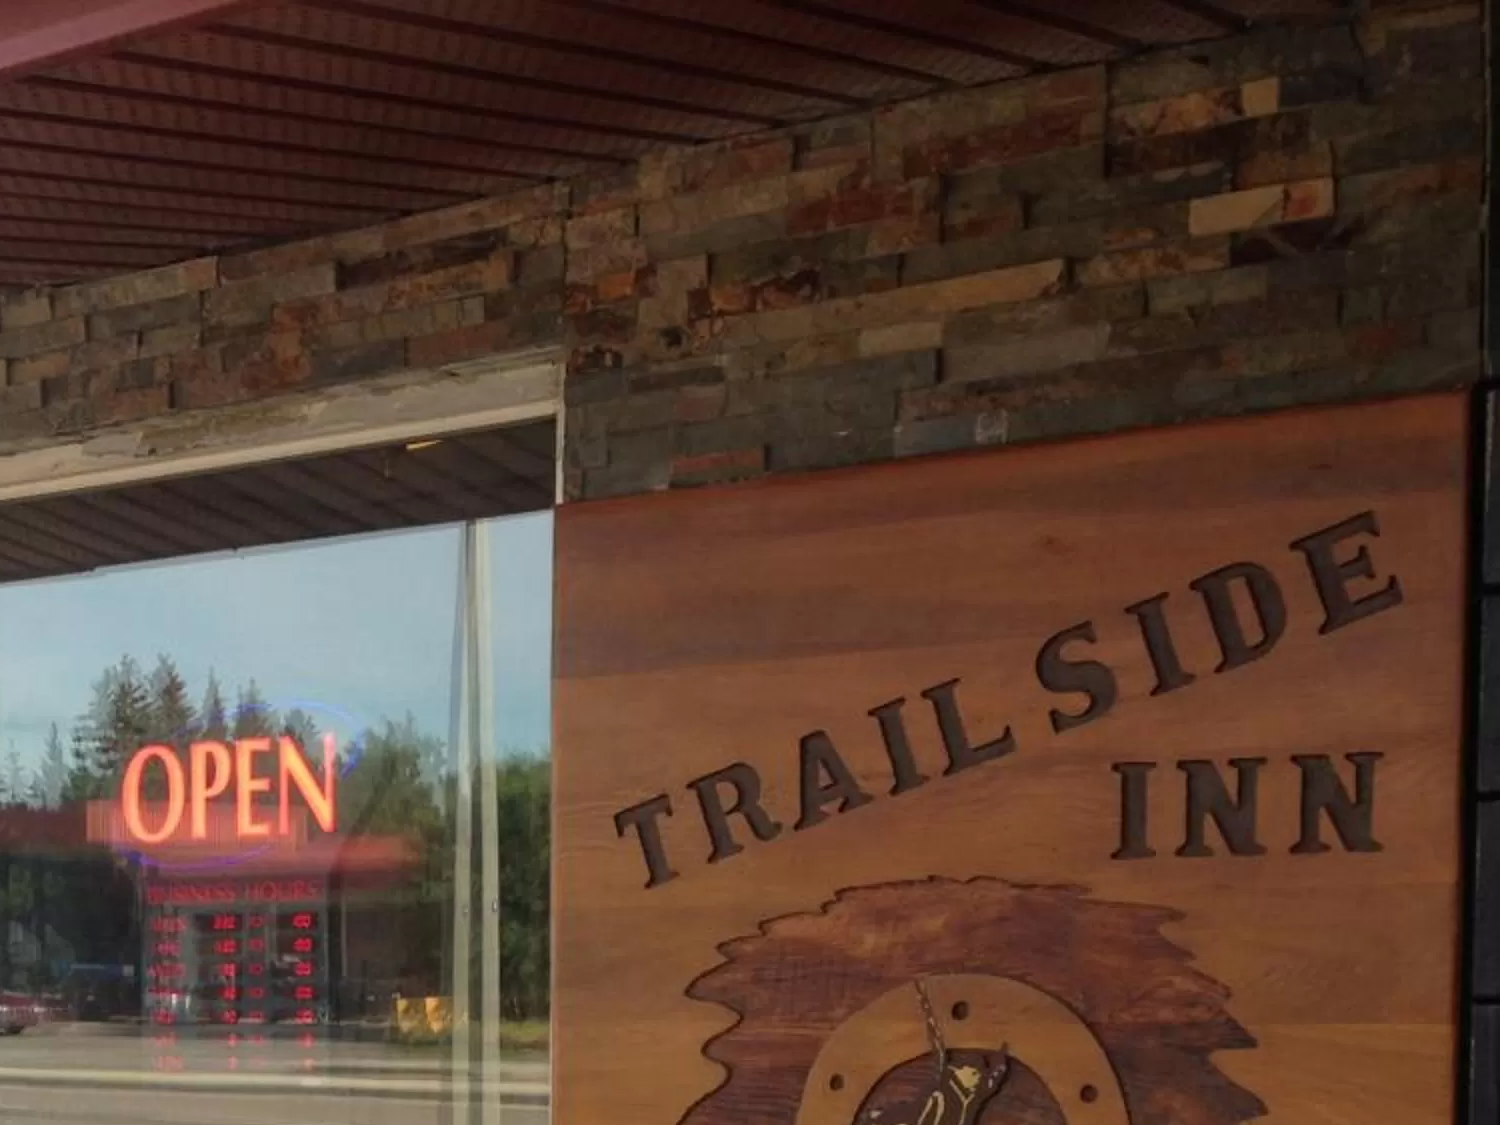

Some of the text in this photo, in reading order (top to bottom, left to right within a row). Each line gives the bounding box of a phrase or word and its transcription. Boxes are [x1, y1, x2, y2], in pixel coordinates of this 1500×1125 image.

[613, 509, 1405, 890] TRAILSIDE
[121, 732, 338, 845] OPEN
[1110, 751, 1386, 861] INN
[245, 880, 320, 901] HOURS
